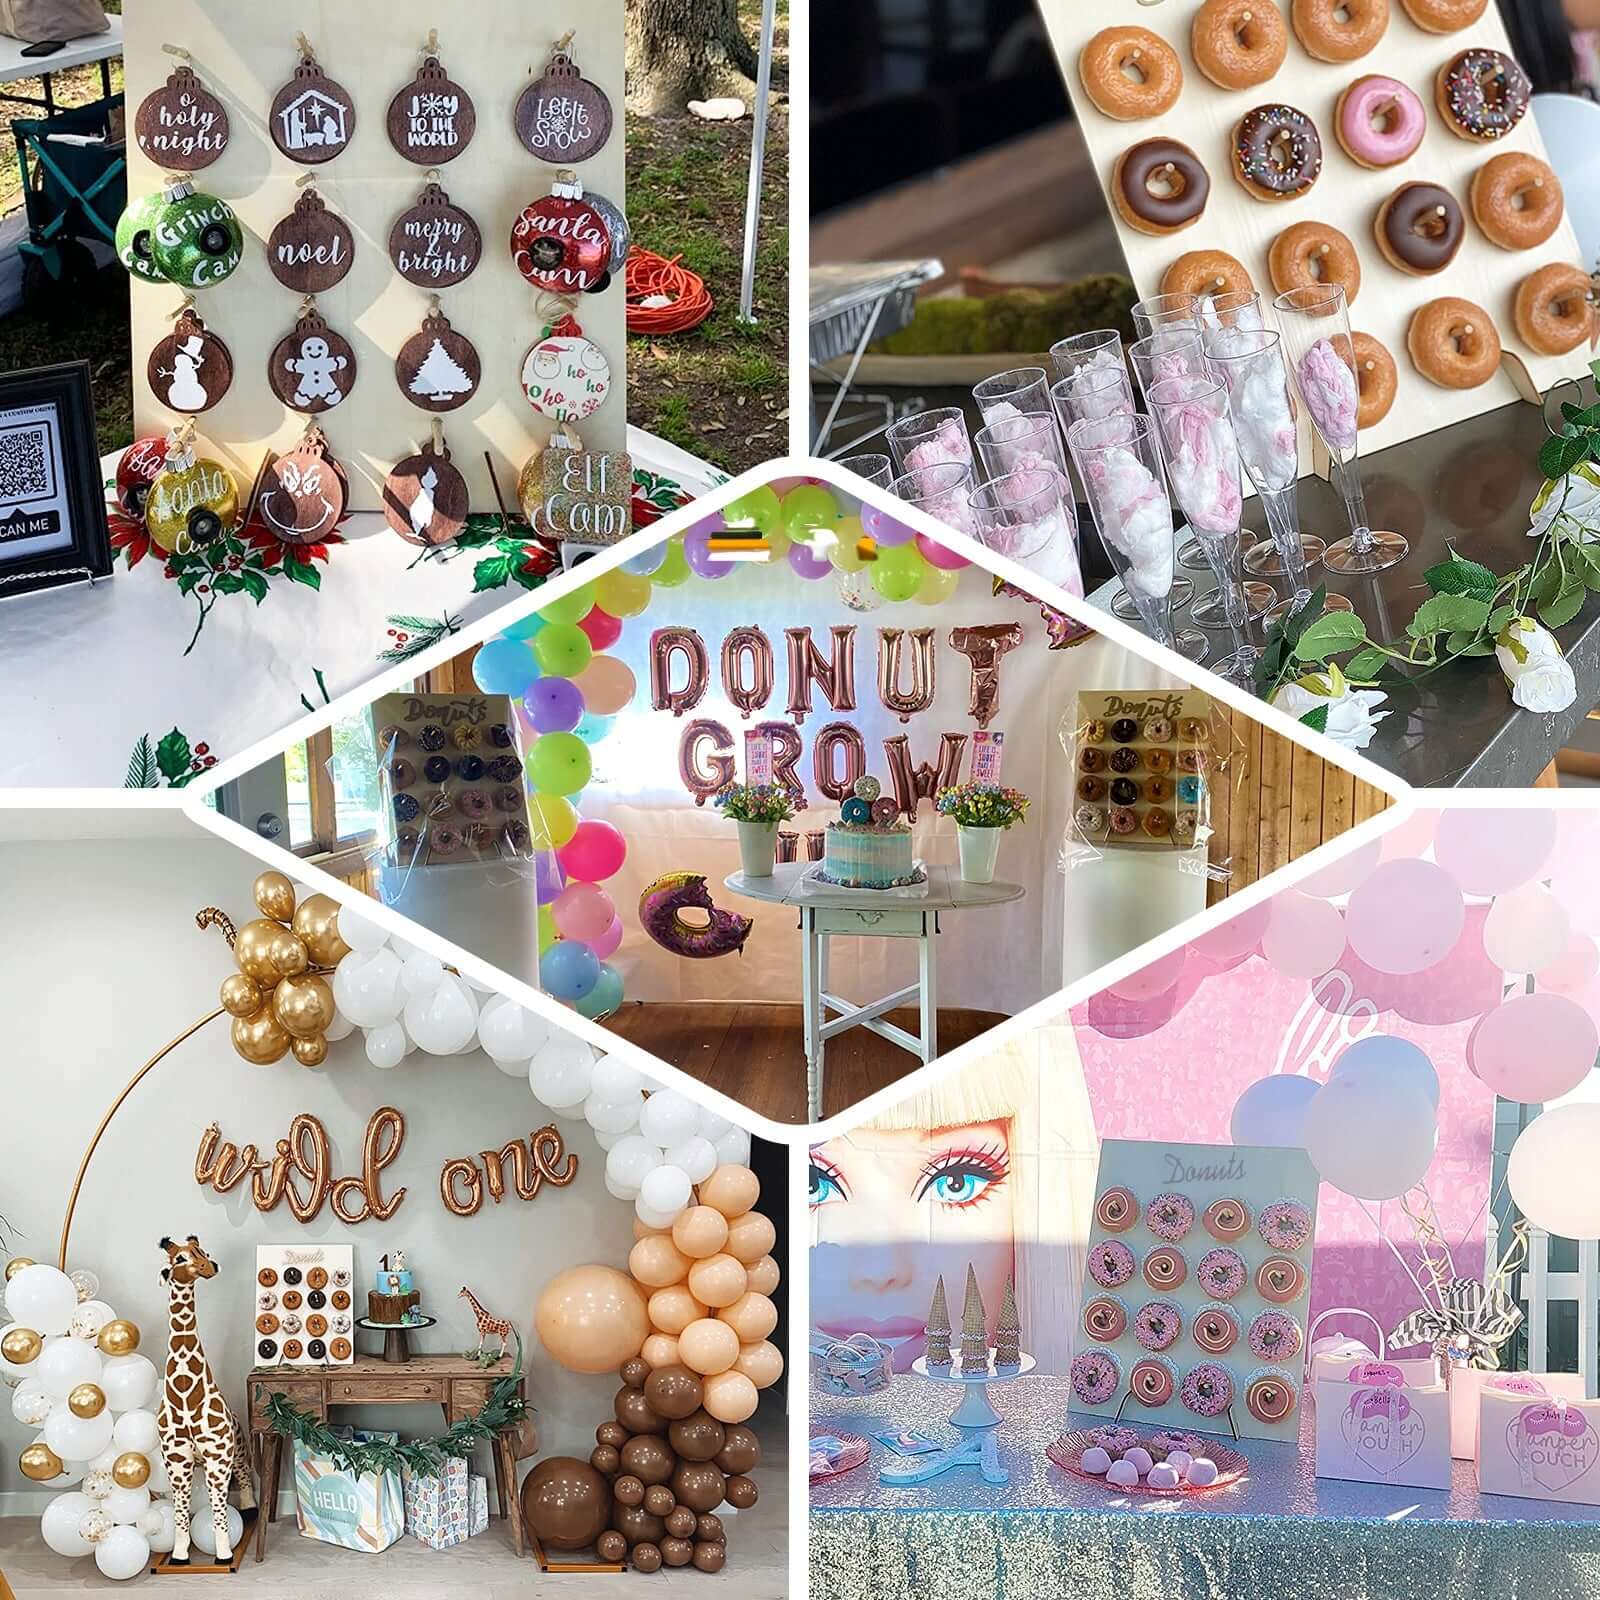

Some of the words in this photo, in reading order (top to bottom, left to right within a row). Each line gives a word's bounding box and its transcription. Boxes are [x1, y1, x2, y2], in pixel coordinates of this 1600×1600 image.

[159, 105, 220, 131] holy
[410, 117, 428, 132] TO
[431, 117, 454, 132] THE
[139, 131, 227, 156] night
[407, 131, 458, 147] WORLD
[531, 119, 591, 149] Snow
[405, 218, 465, 243] merry
[514, 207, 609, 251] Santa
[278, 236, 346, 265] noel
[427, 235, 442, 256] &
[399, 248, 472, 277] bright
[567, 364, 588, 379] ho
[586, 379, 605, 393] ho
[562, 454, 611, 497] Elf
[0, 521, 27, 538] CAN
[29, 518, 50, 533] ME
[545, 492, 628, 537] Cam
[649, 624, 1026, 730] DONUT
[401, 696, 489, 728] Donuts
[1102, 694, 1186, 723] Donuts
[678, 716, 969, 826] GROW
[194, 1106, 408, 1225] wild
[439, 1122, 578, 1217] one
[1162, 1151, 1248, 1185] Donuts
[312, 1490, 358, 1514] HELLO
